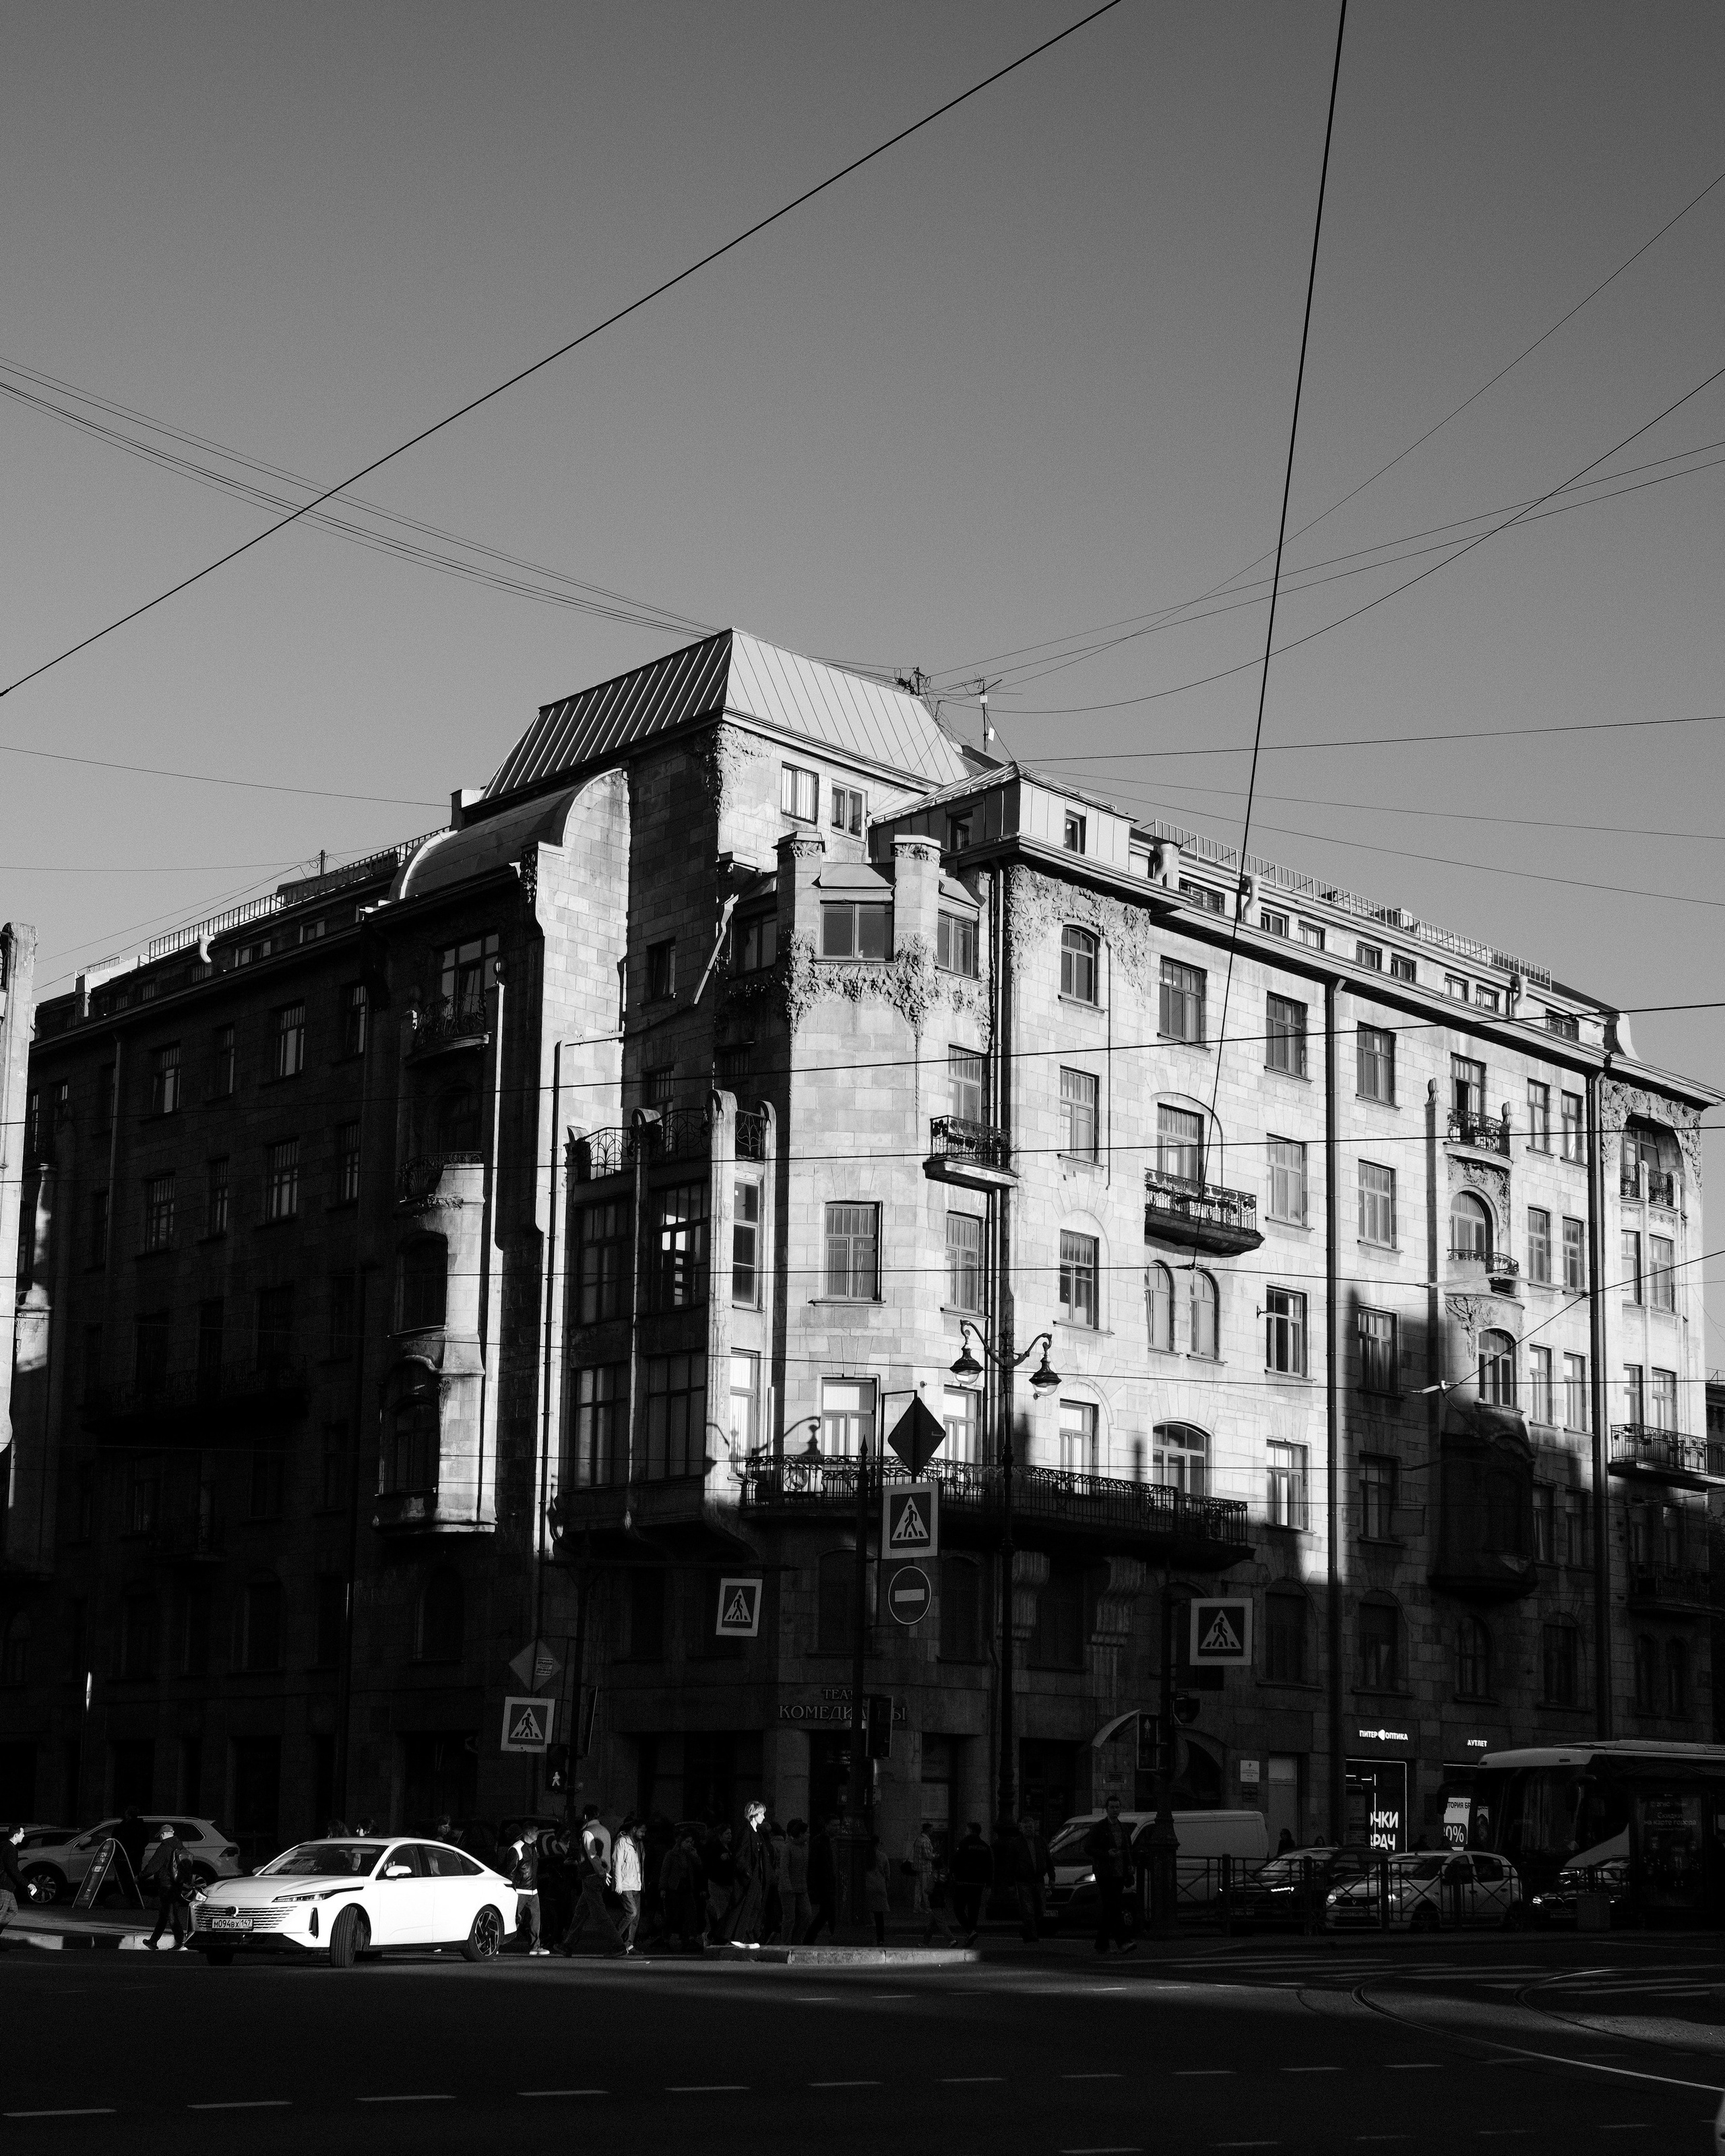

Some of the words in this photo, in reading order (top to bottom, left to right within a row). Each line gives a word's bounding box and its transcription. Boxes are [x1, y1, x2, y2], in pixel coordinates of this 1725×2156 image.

[823, 1688, 865, 1700] ТЕАТ
[779, 1705, 906, 1720] КОМЕДИЫ
[1359, 1730, 1378, 1738] ПИТЕР
[1385, 1732, 1408, 1741] ОПТИКА
[1467, 1739, 1488, 1747] АУТЛЕТ
[1443, 1825, 1464, 1843] 0%
[214, 1920, 239, 1928] М094ВХ
